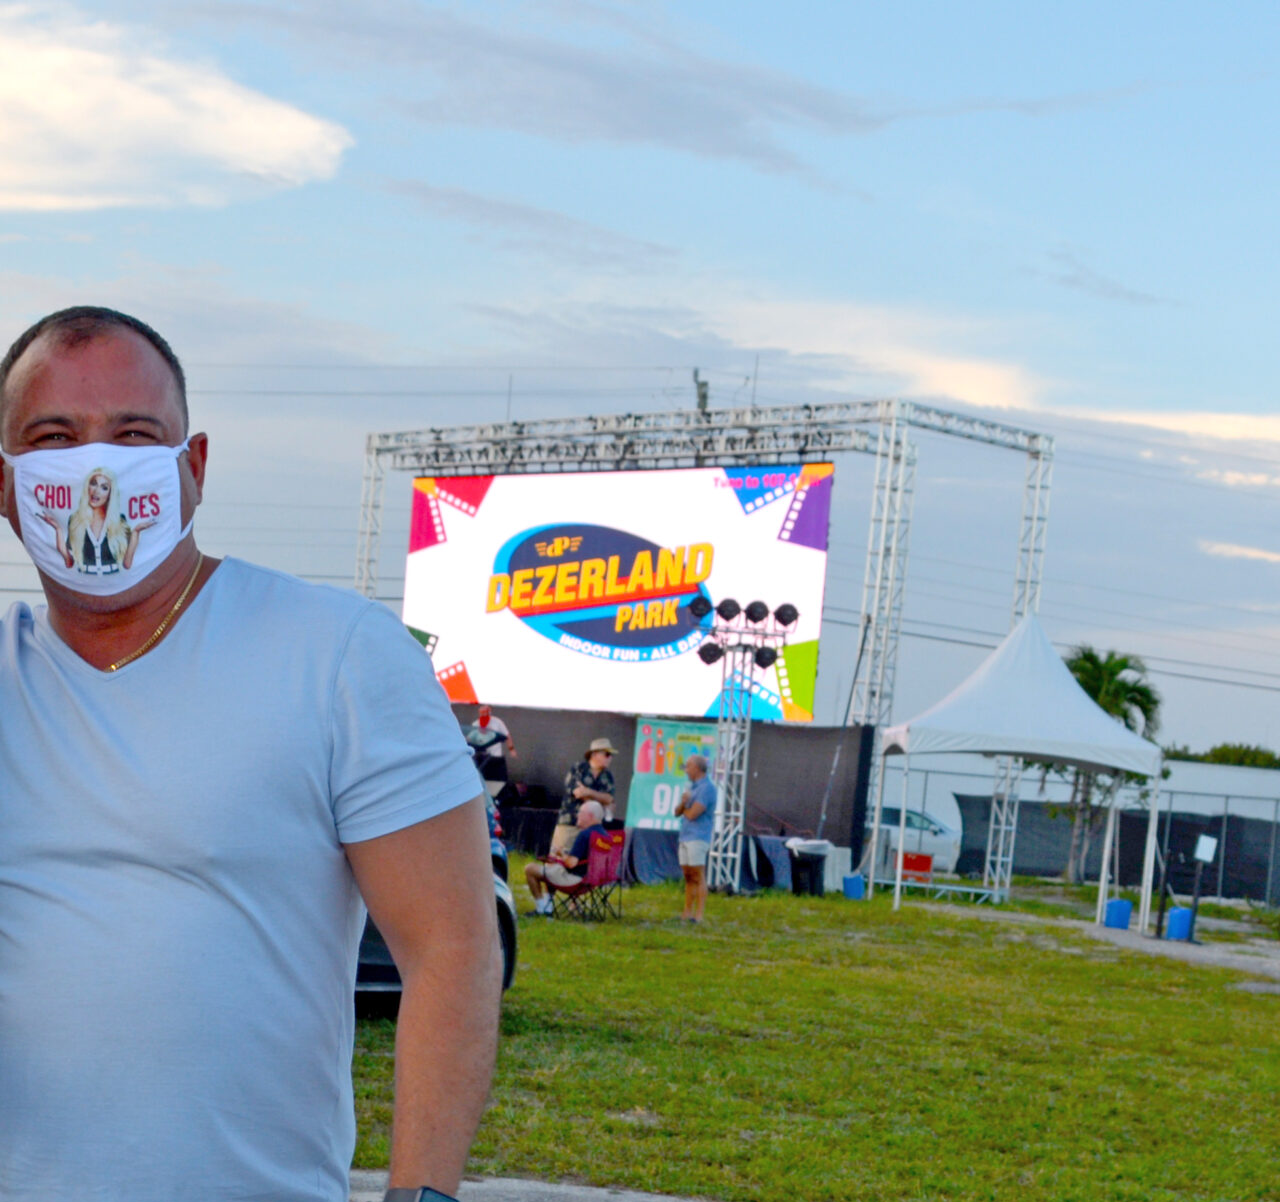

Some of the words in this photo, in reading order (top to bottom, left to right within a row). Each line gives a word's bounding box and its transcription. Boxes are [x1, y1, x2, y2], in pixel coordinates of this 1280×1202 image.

[485, 542, 715, 614] DEZERLAND
[614, 598, 680, 632] PARK
[559, 633, 611, 658] INDOOR
[613, 648, 640, 661] FUN
[651, 645, 676, 660] ALL
